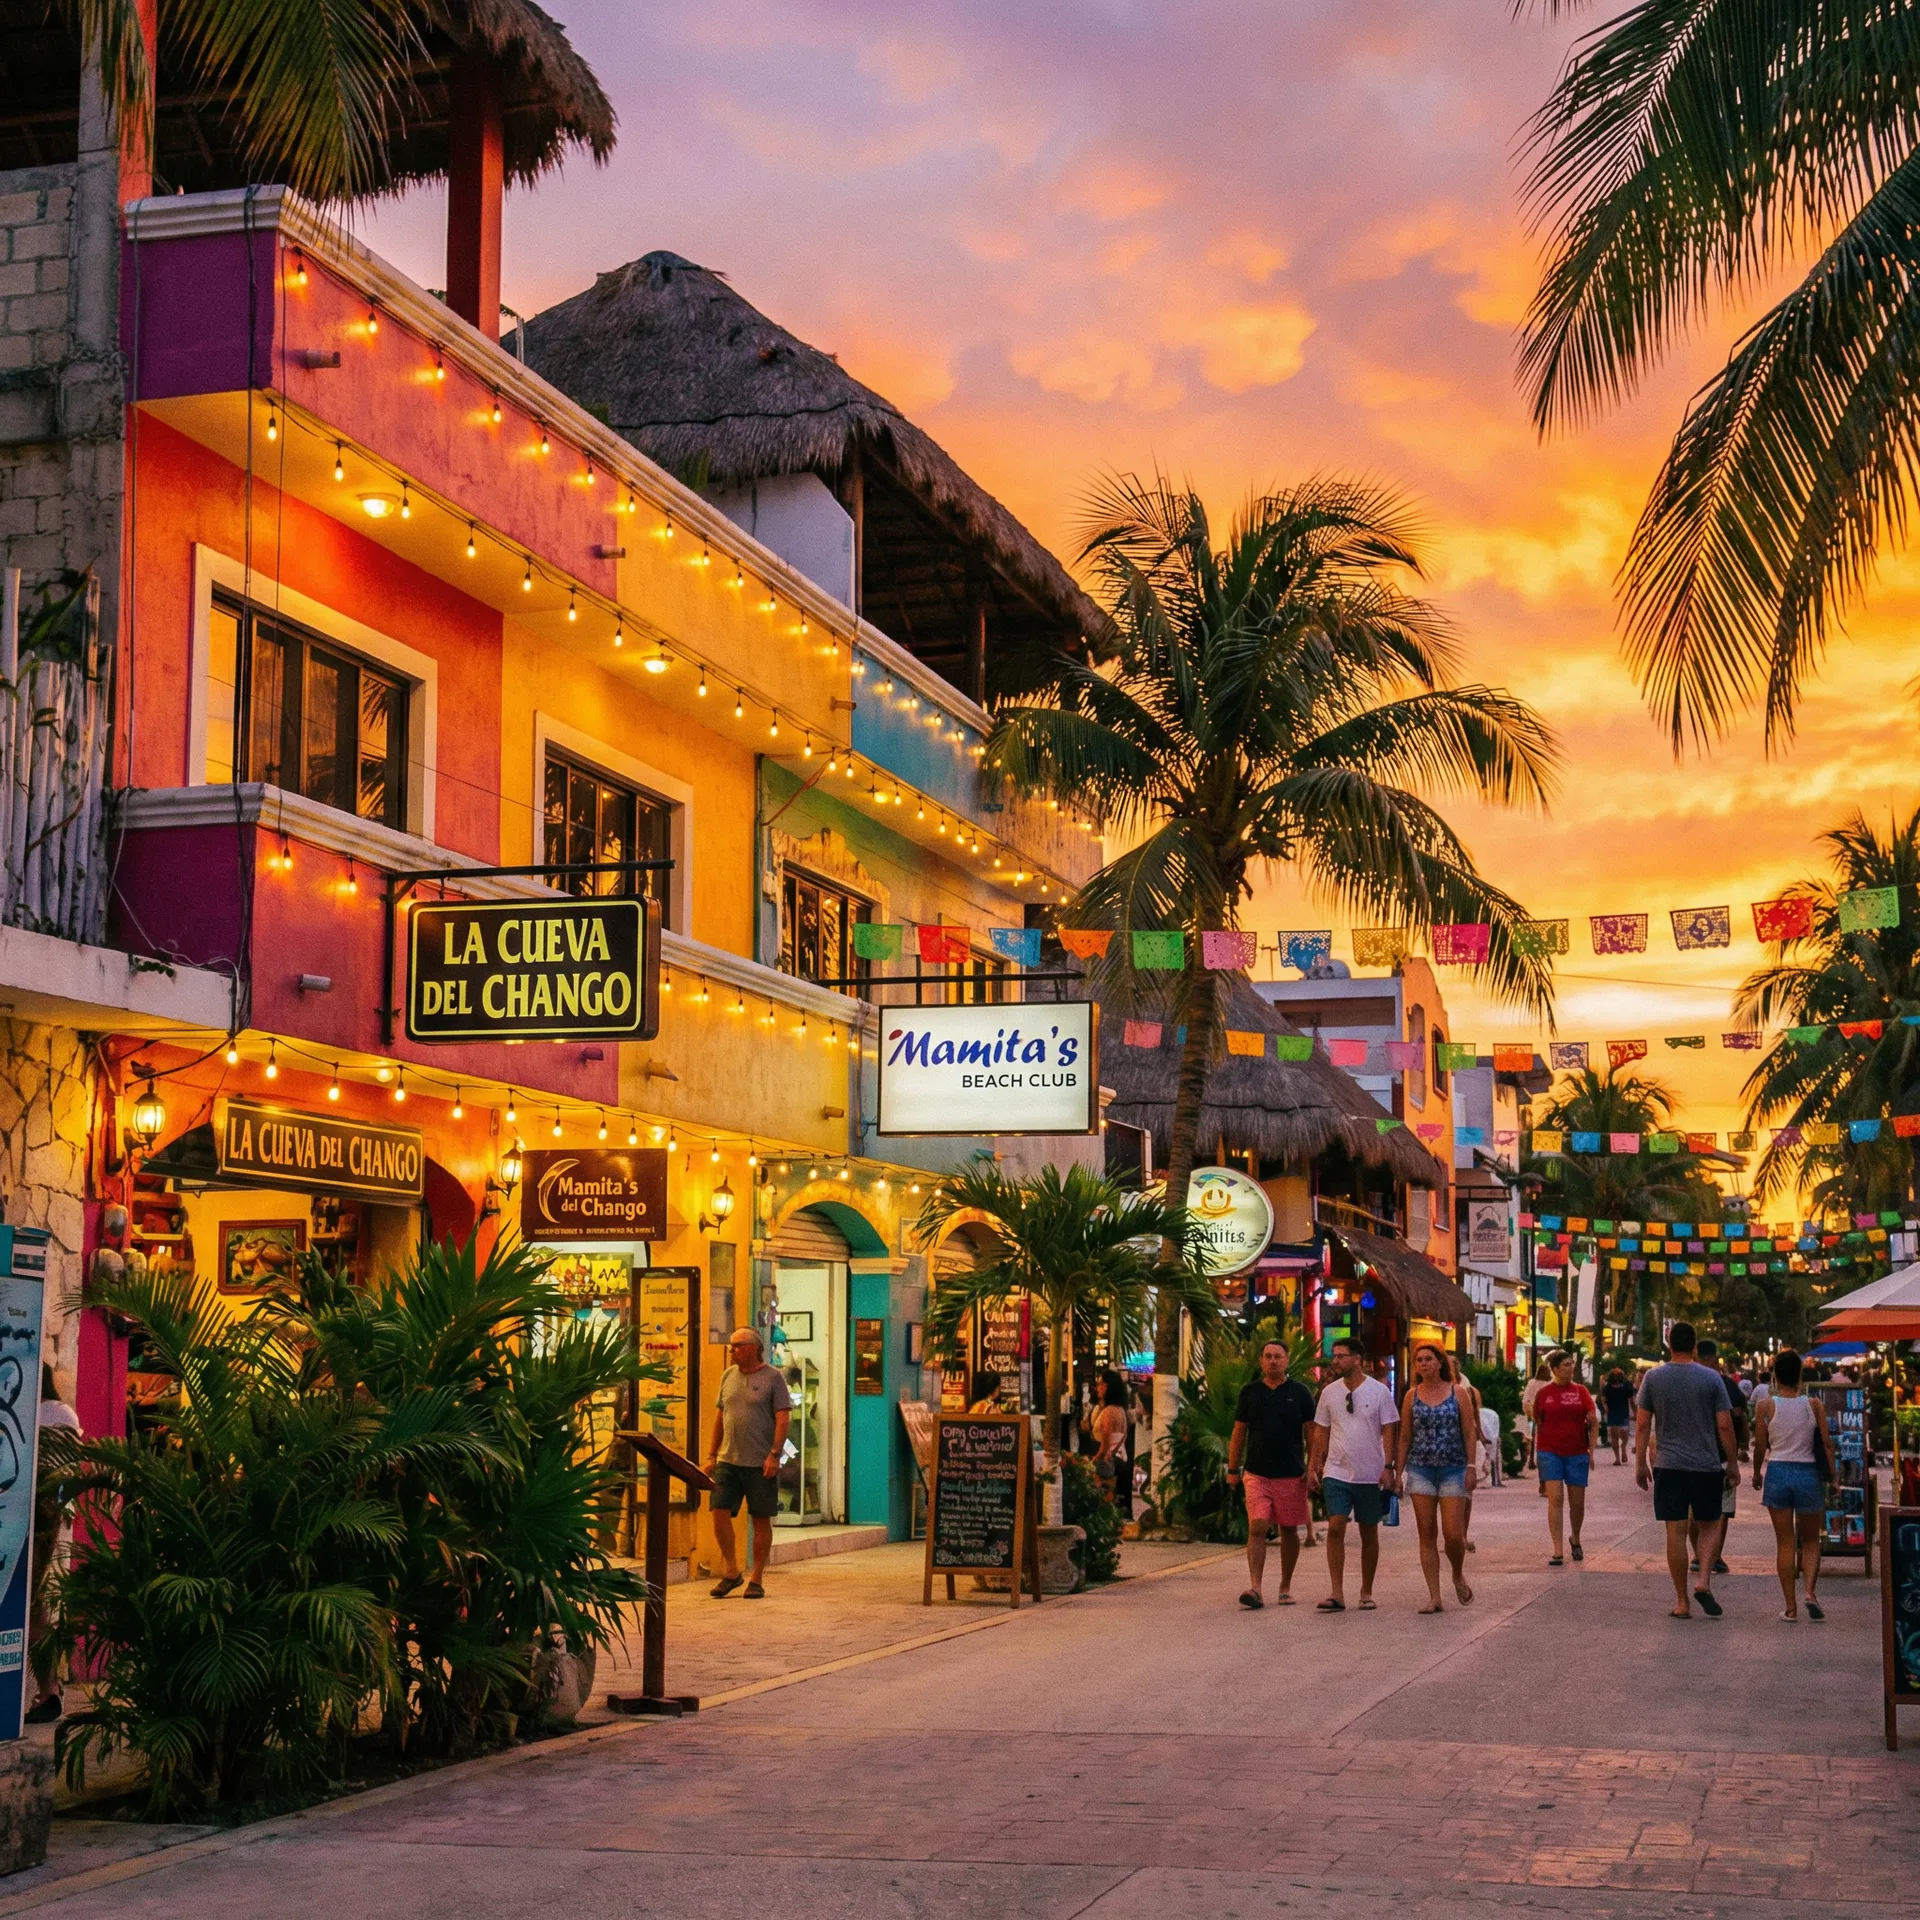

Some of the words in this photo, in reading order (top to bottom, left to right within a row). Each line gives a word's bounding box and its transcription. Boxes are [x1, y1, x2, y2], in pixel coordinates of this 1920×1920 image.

[444, 921, 488, 965] LA
[497, 917, 611, 964] CUEVA
[422, 980, 473, 1016] DEL
[482, 971, 632, 1019] CHANGO
[887, 1026, 1079, 1068] Mamita's
[962, 1074, 1023, 1088] BEACH
[1029, 1073, 1077, 1087] CLUB
[229, 1117, 253, 1161] LA
[258, 1121, 316, 1169] CUEVA
[320, 1135, 344, 1168] DEL
[349, 1135, 418, 1182] CHANGO
[557, 1176, 639, 1196] Mamita's
[561, 1198, 578, 1212] del
[580, 1197, 647, 1221] Chango
